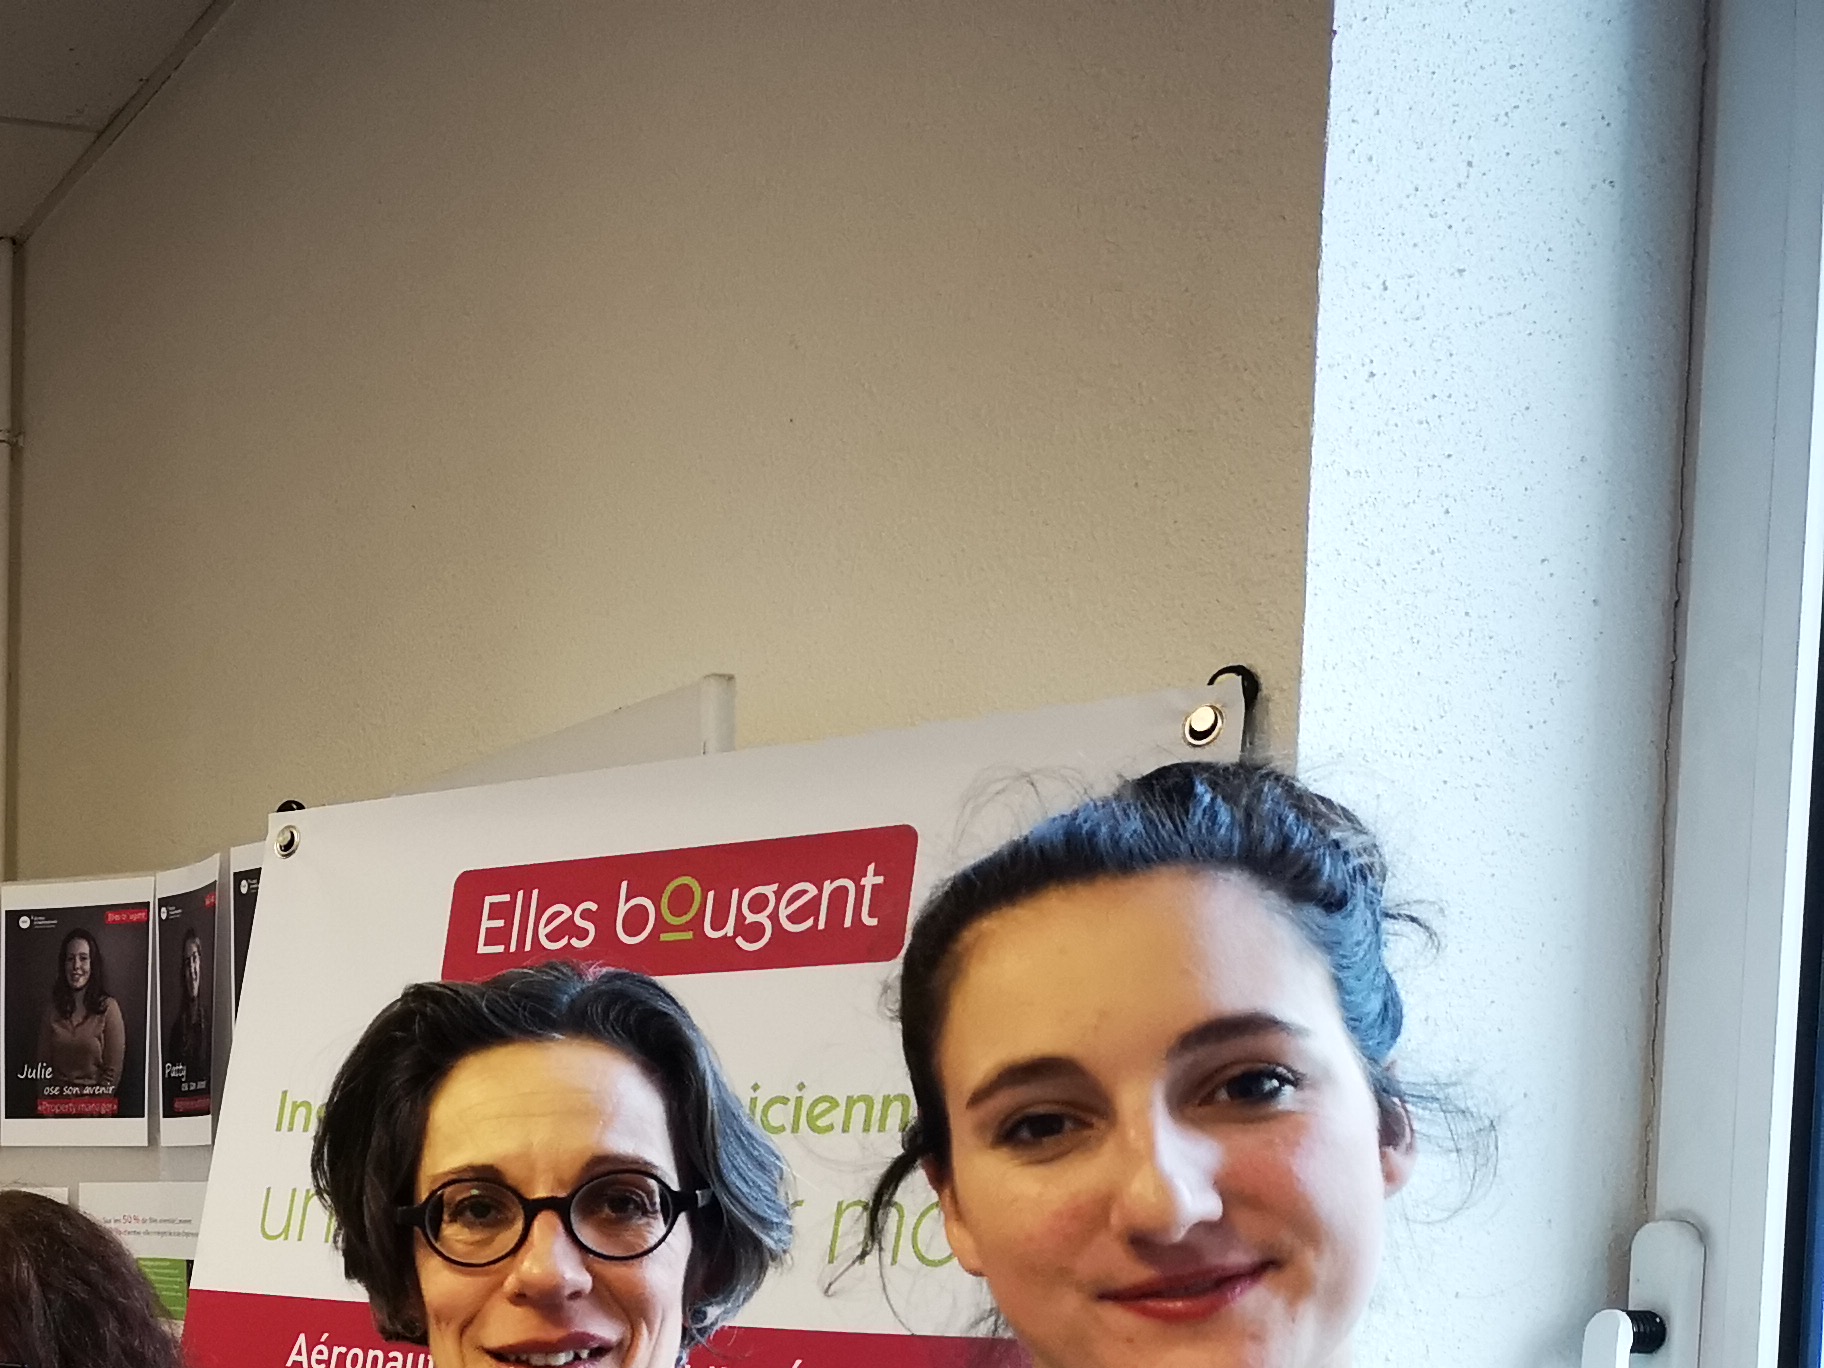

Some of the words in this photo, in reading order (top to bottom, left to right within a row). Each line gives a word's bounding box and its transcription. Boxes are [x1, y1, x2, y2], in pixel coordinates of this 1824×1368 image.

[476, 888, 599, 955] Elles
[16, 1062, 53, 1080] Julie
[43, 1085, 61, 1095] ose
[62, 1085, 81, 1095] son
[83, 1081, 116, 1095] avenir
